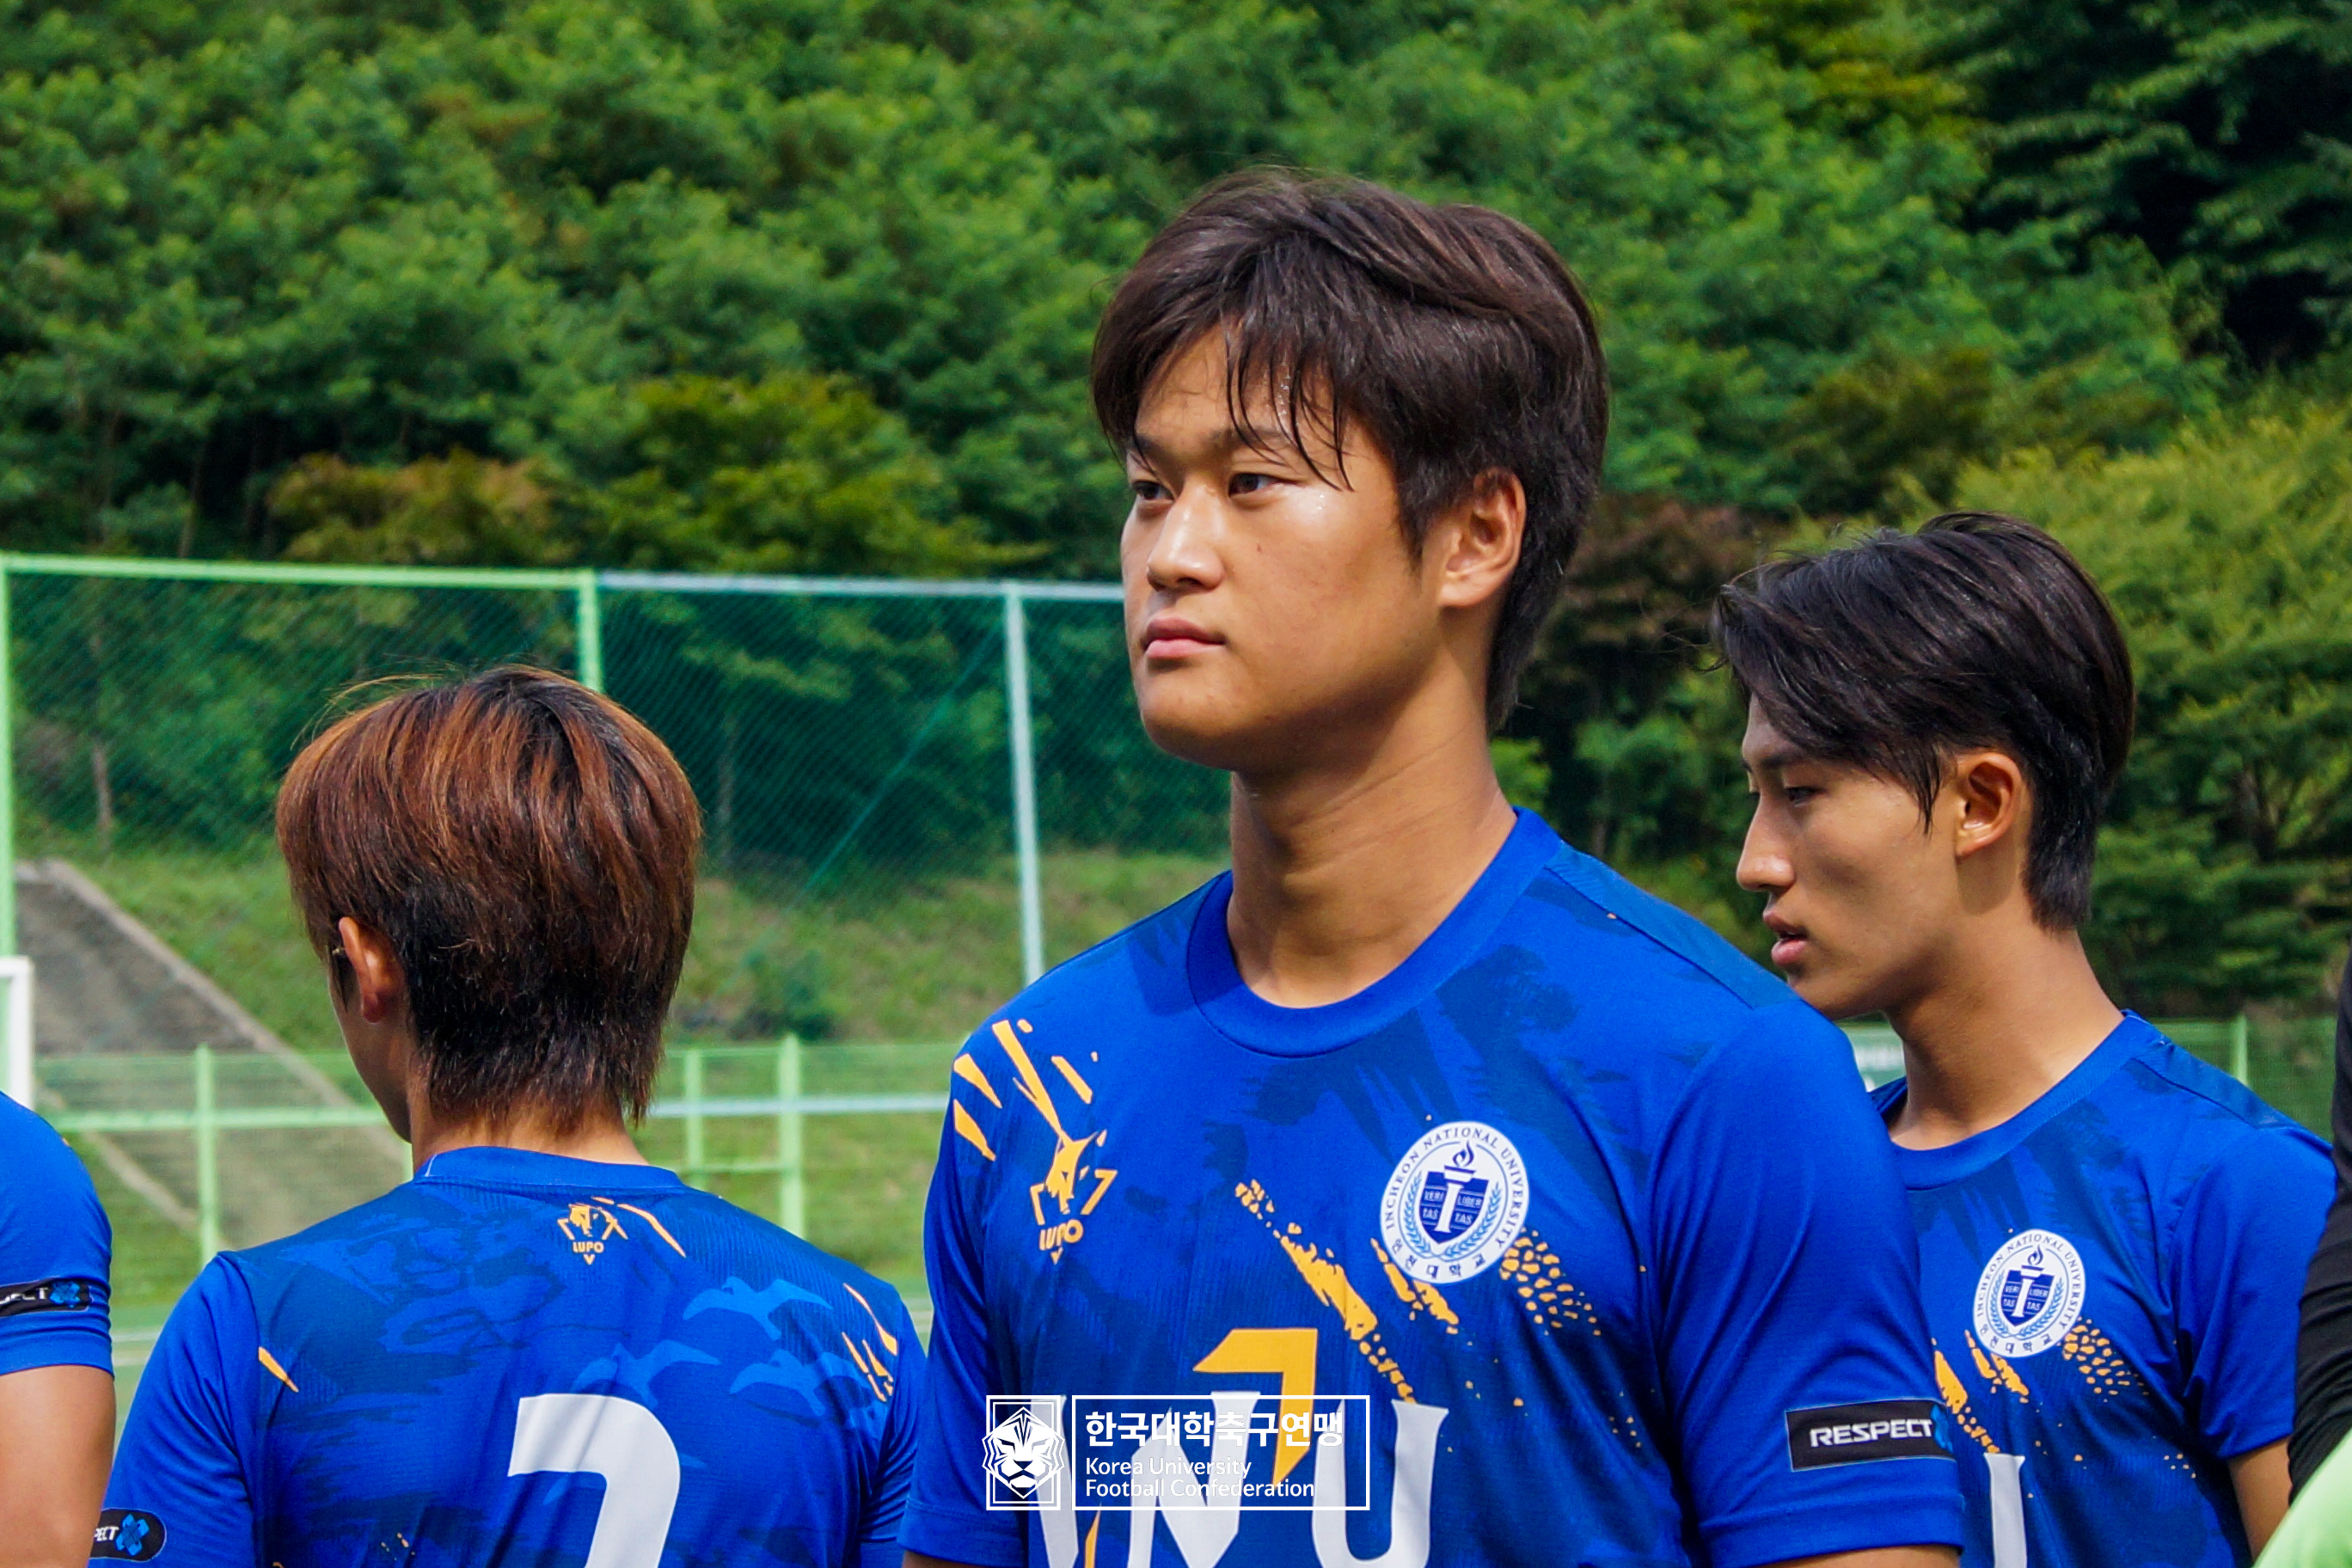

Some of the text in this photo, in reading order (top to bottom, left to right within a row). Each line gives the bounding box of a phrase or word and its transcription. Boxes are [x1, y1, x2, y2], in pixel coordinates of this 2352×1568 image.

[1386, 1127, 1523, 1248] INCHEON NATIONAL UNIVERSITY
[573, 1241, 604, 1253] LUPO
[1039, 1219, 1083, 1251] LUPO
[1976, 1234, 2081, 1329] INCHEON NATIONAL UNIVERSITY
[1810, 1418, 1932, 1448] RESPECT
